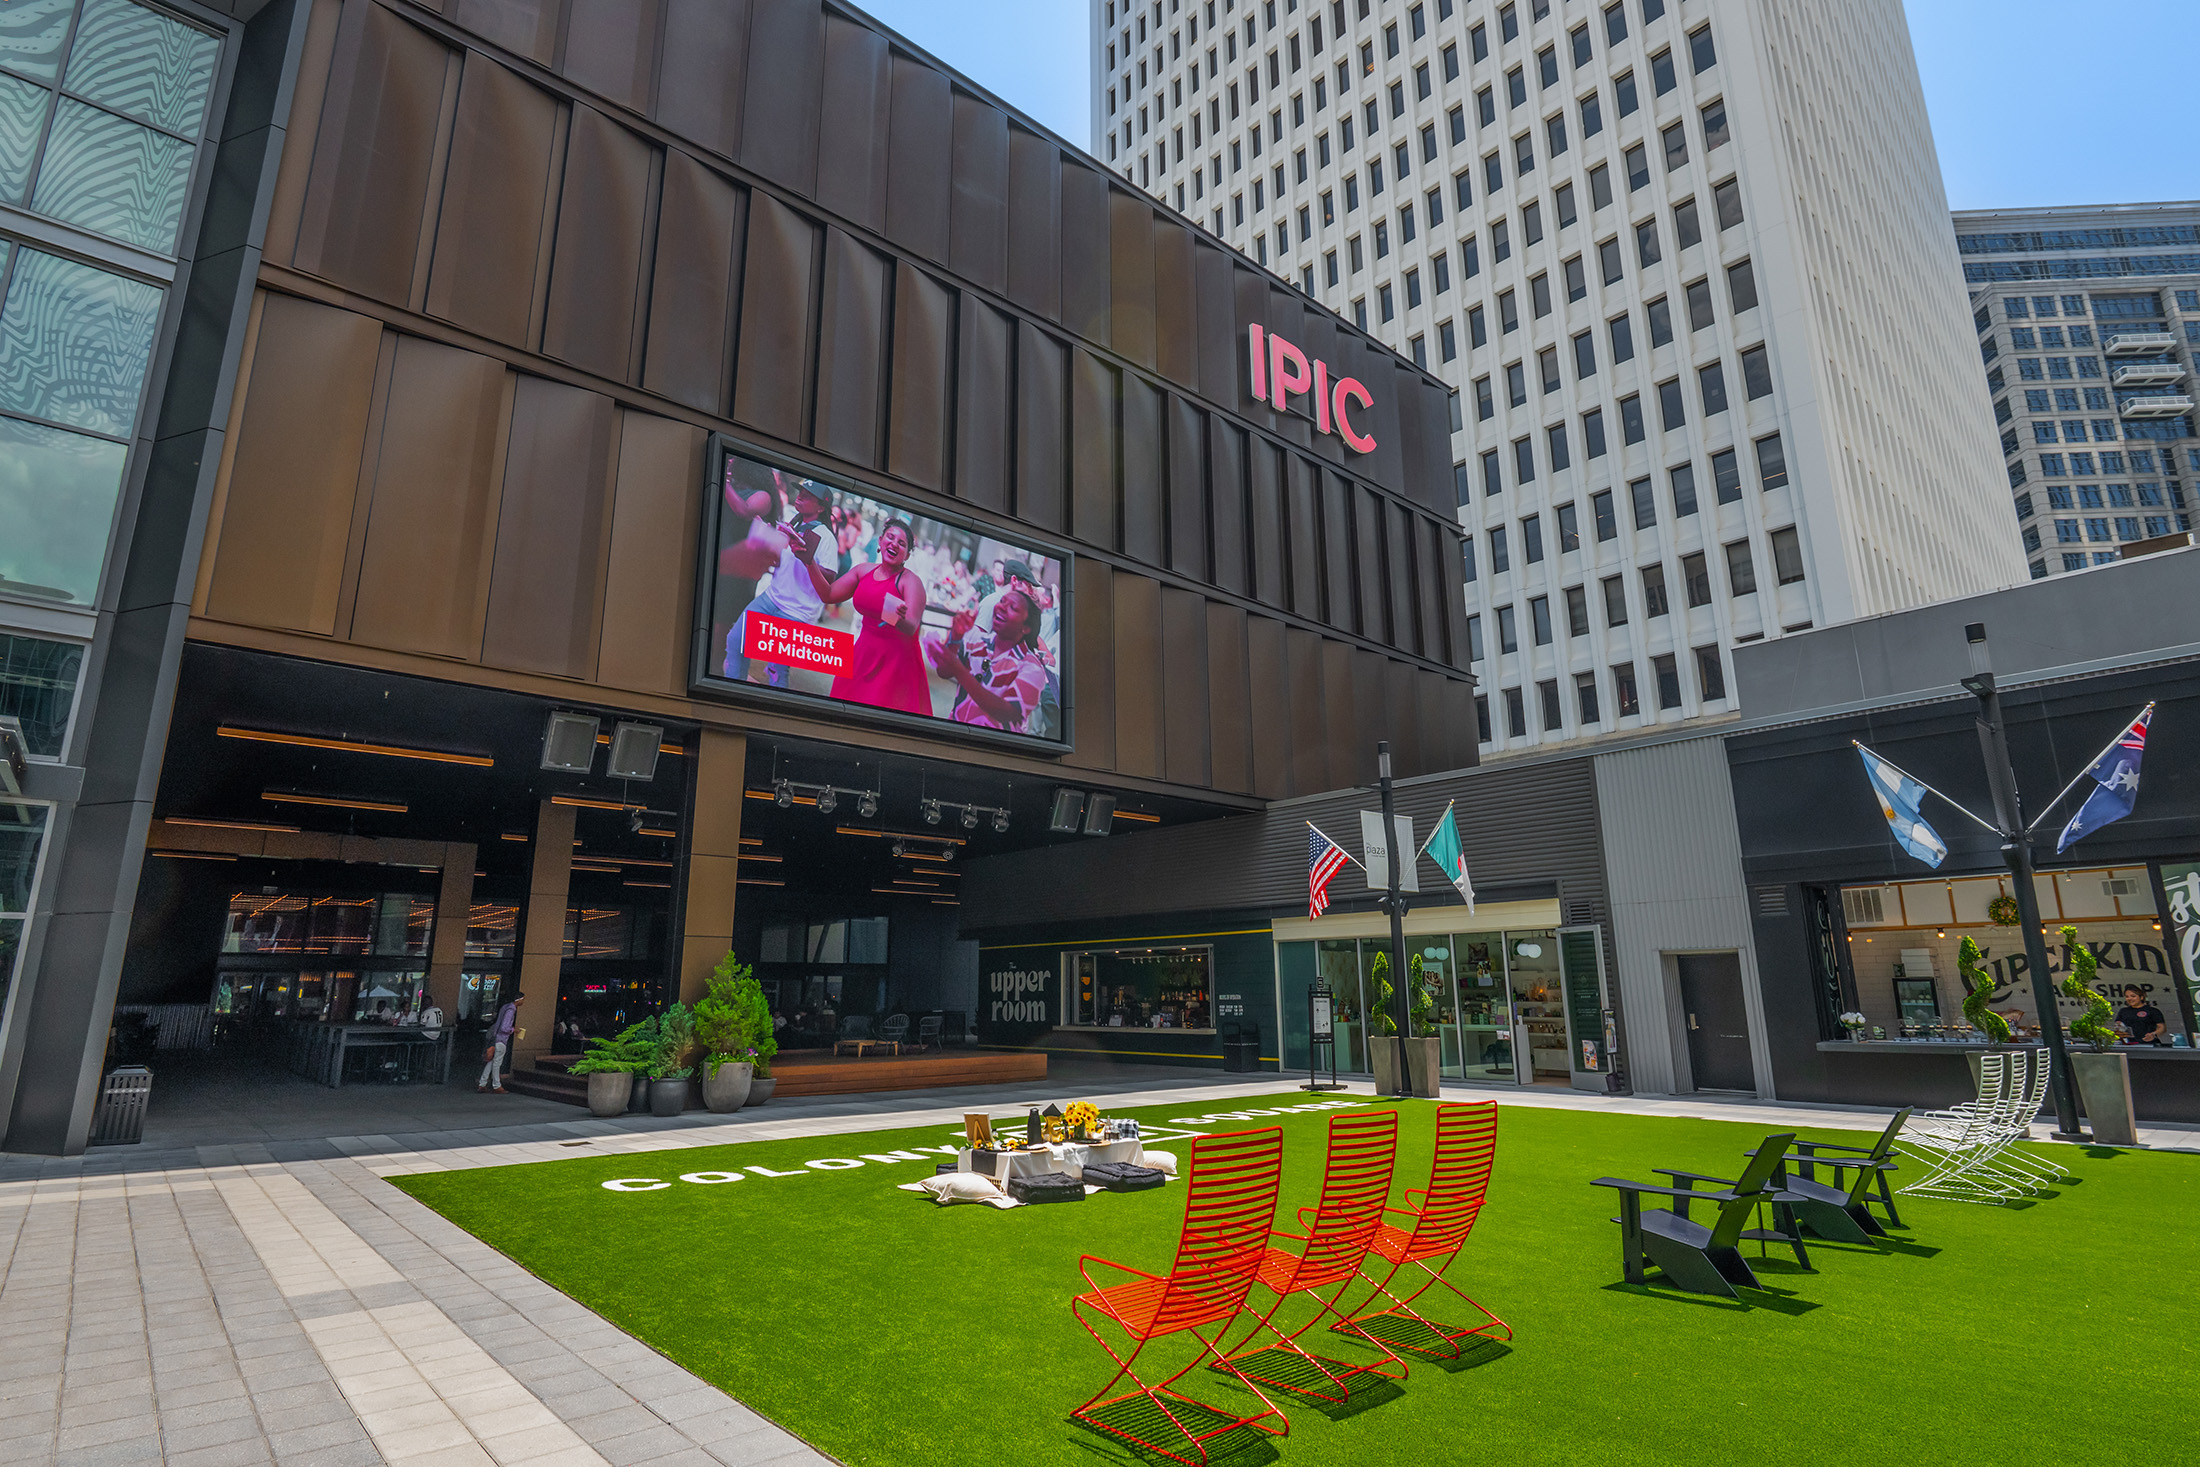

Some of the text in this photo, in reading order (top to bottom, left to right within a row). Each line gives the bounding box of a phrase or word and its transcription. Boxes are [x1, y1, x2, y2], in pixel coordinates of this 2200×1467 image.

[1249, 322, 1377, 454] IPIC
[759, 620, 835, 650] The Heart
[758, 640, 843, 667] of Midtown
[991, 970, 1051, 1001] upper
[2096, 983, 2154, 998] SHP
[991, 1000, 1046, 1022] room
[601, 1101, 1372, 1192] COLONY SQUARE
